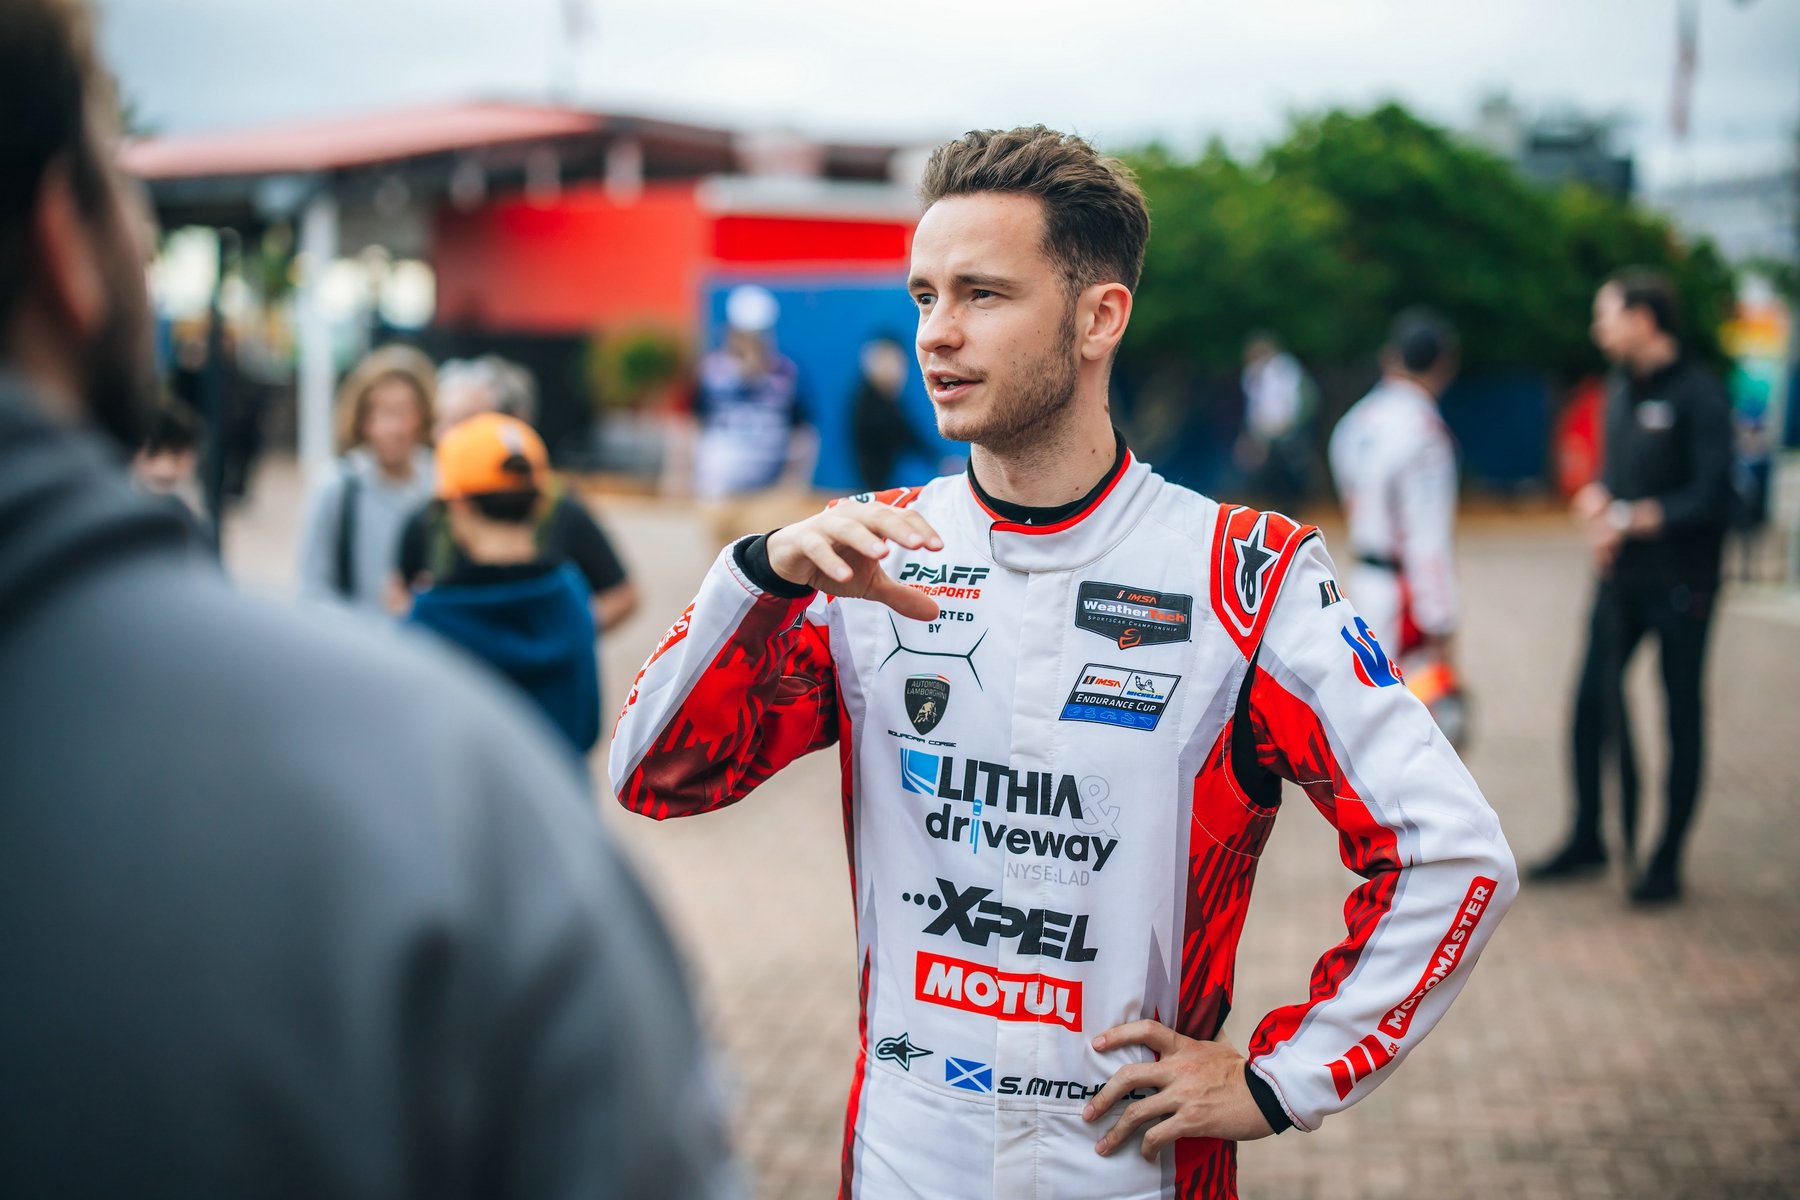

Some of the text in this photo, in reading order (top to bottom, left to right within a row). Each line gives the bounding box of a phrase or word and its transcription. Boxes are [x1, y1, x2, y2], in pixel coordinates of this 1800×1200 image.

[900, 563, 990, 585] PFAFF
[1127, 593, 1157, 605] IMSA
[1083, 600, 1185, 623] WeatherTech
[928, 624, 941, 633] BY
[906, 687, 948, 701] LAMBORGHINI
[1095, 678, 1165, 700] IMSA MICHELIN
[1075, 694, 1134, 710] ENDURANCE
[938, 756, 1083, 820] LITHIA
[925, 799, 1118, 872] driveway
[1006, 862, 1090, 886] NYSE:LAD
[922, 877, 1098, 962] XPEL
[1386, 885, 1489, 1030] MOTOMASTER
[922, 961, 1076, 1023] MOTUL
